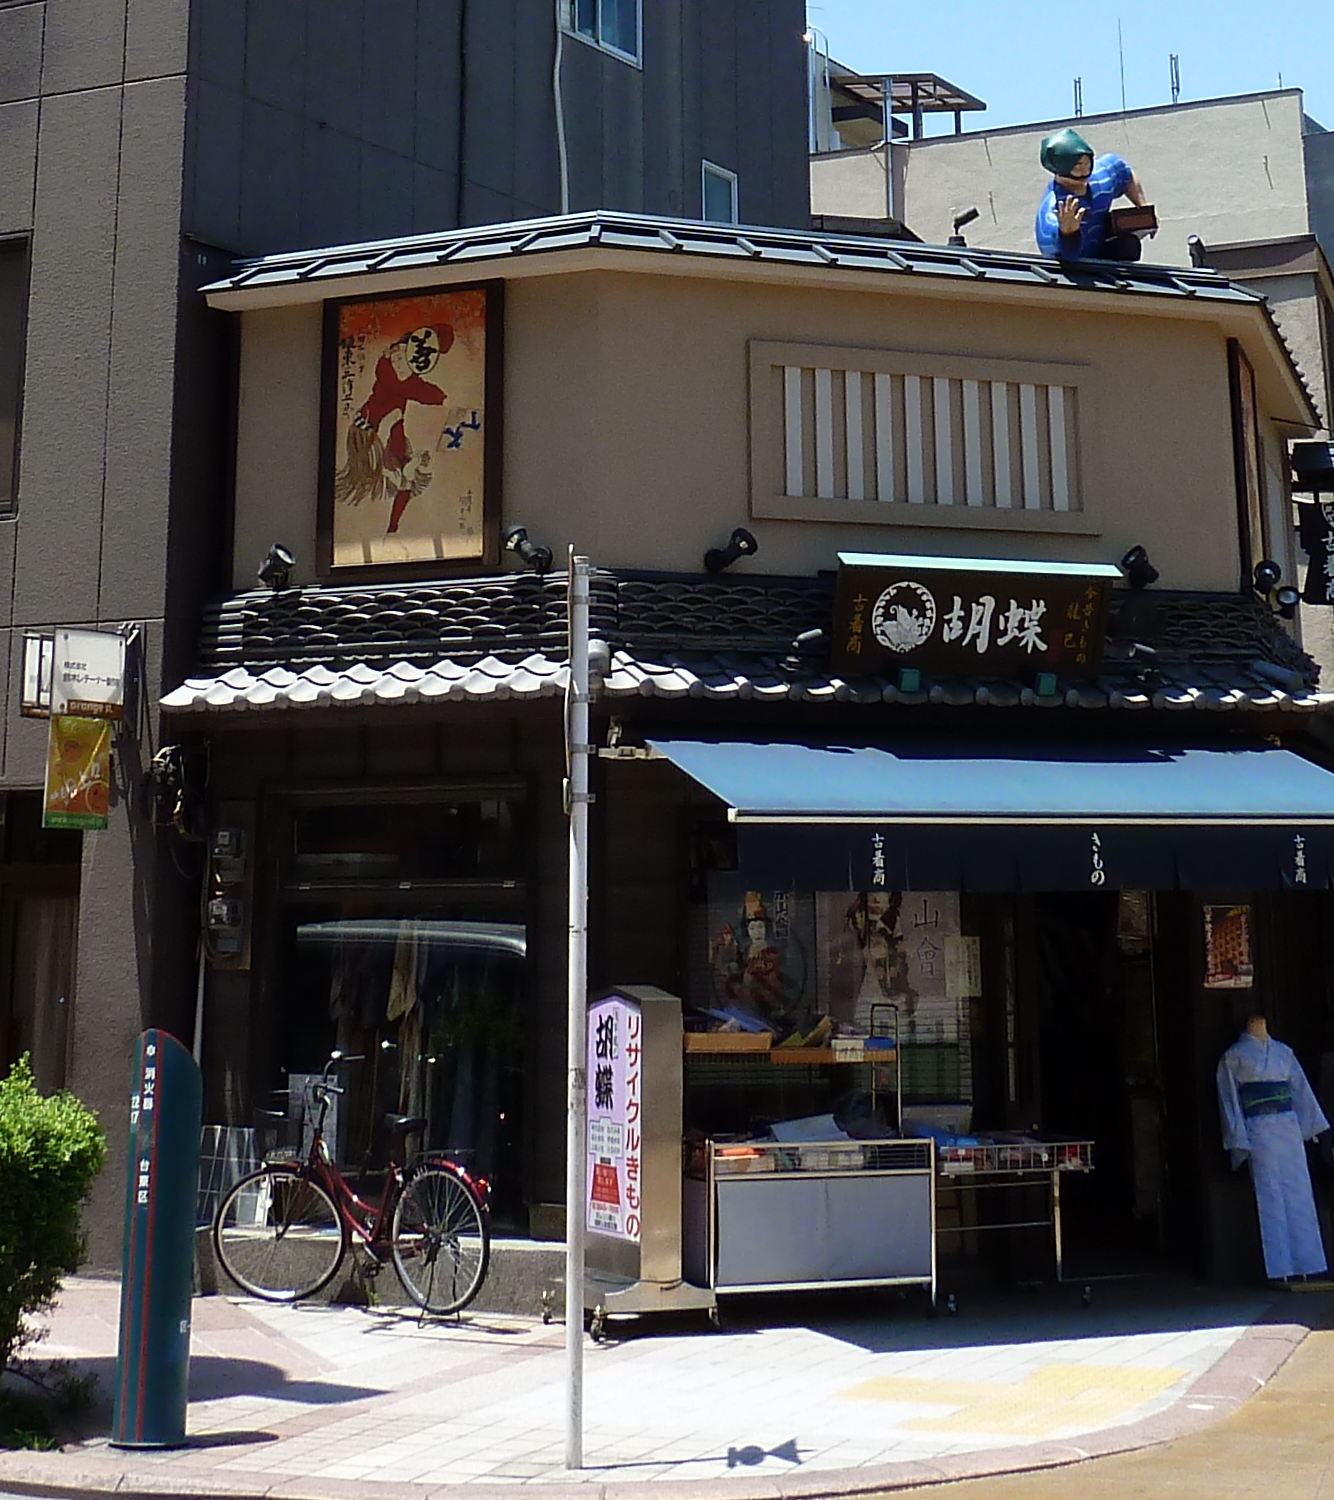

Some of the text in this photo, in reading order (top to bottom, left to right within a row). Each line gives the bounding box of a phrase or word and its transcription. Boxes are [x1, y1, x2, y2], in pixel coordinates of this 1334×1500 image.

[942, 595, 1048, 654] 胡蝶
[872, 833, 885, 886] 古着商
[1090, 832, 1105, 886] きもの
[1293, 834, 1307, 884] 古着商
[595, 1013, 613, 1110] 胡蝶
[143, 1067, 156, 1110] 消火器
[626, 1015, 640, 1238] リサイクルきもの
[138, 1158, 150, 1204] 台東区
